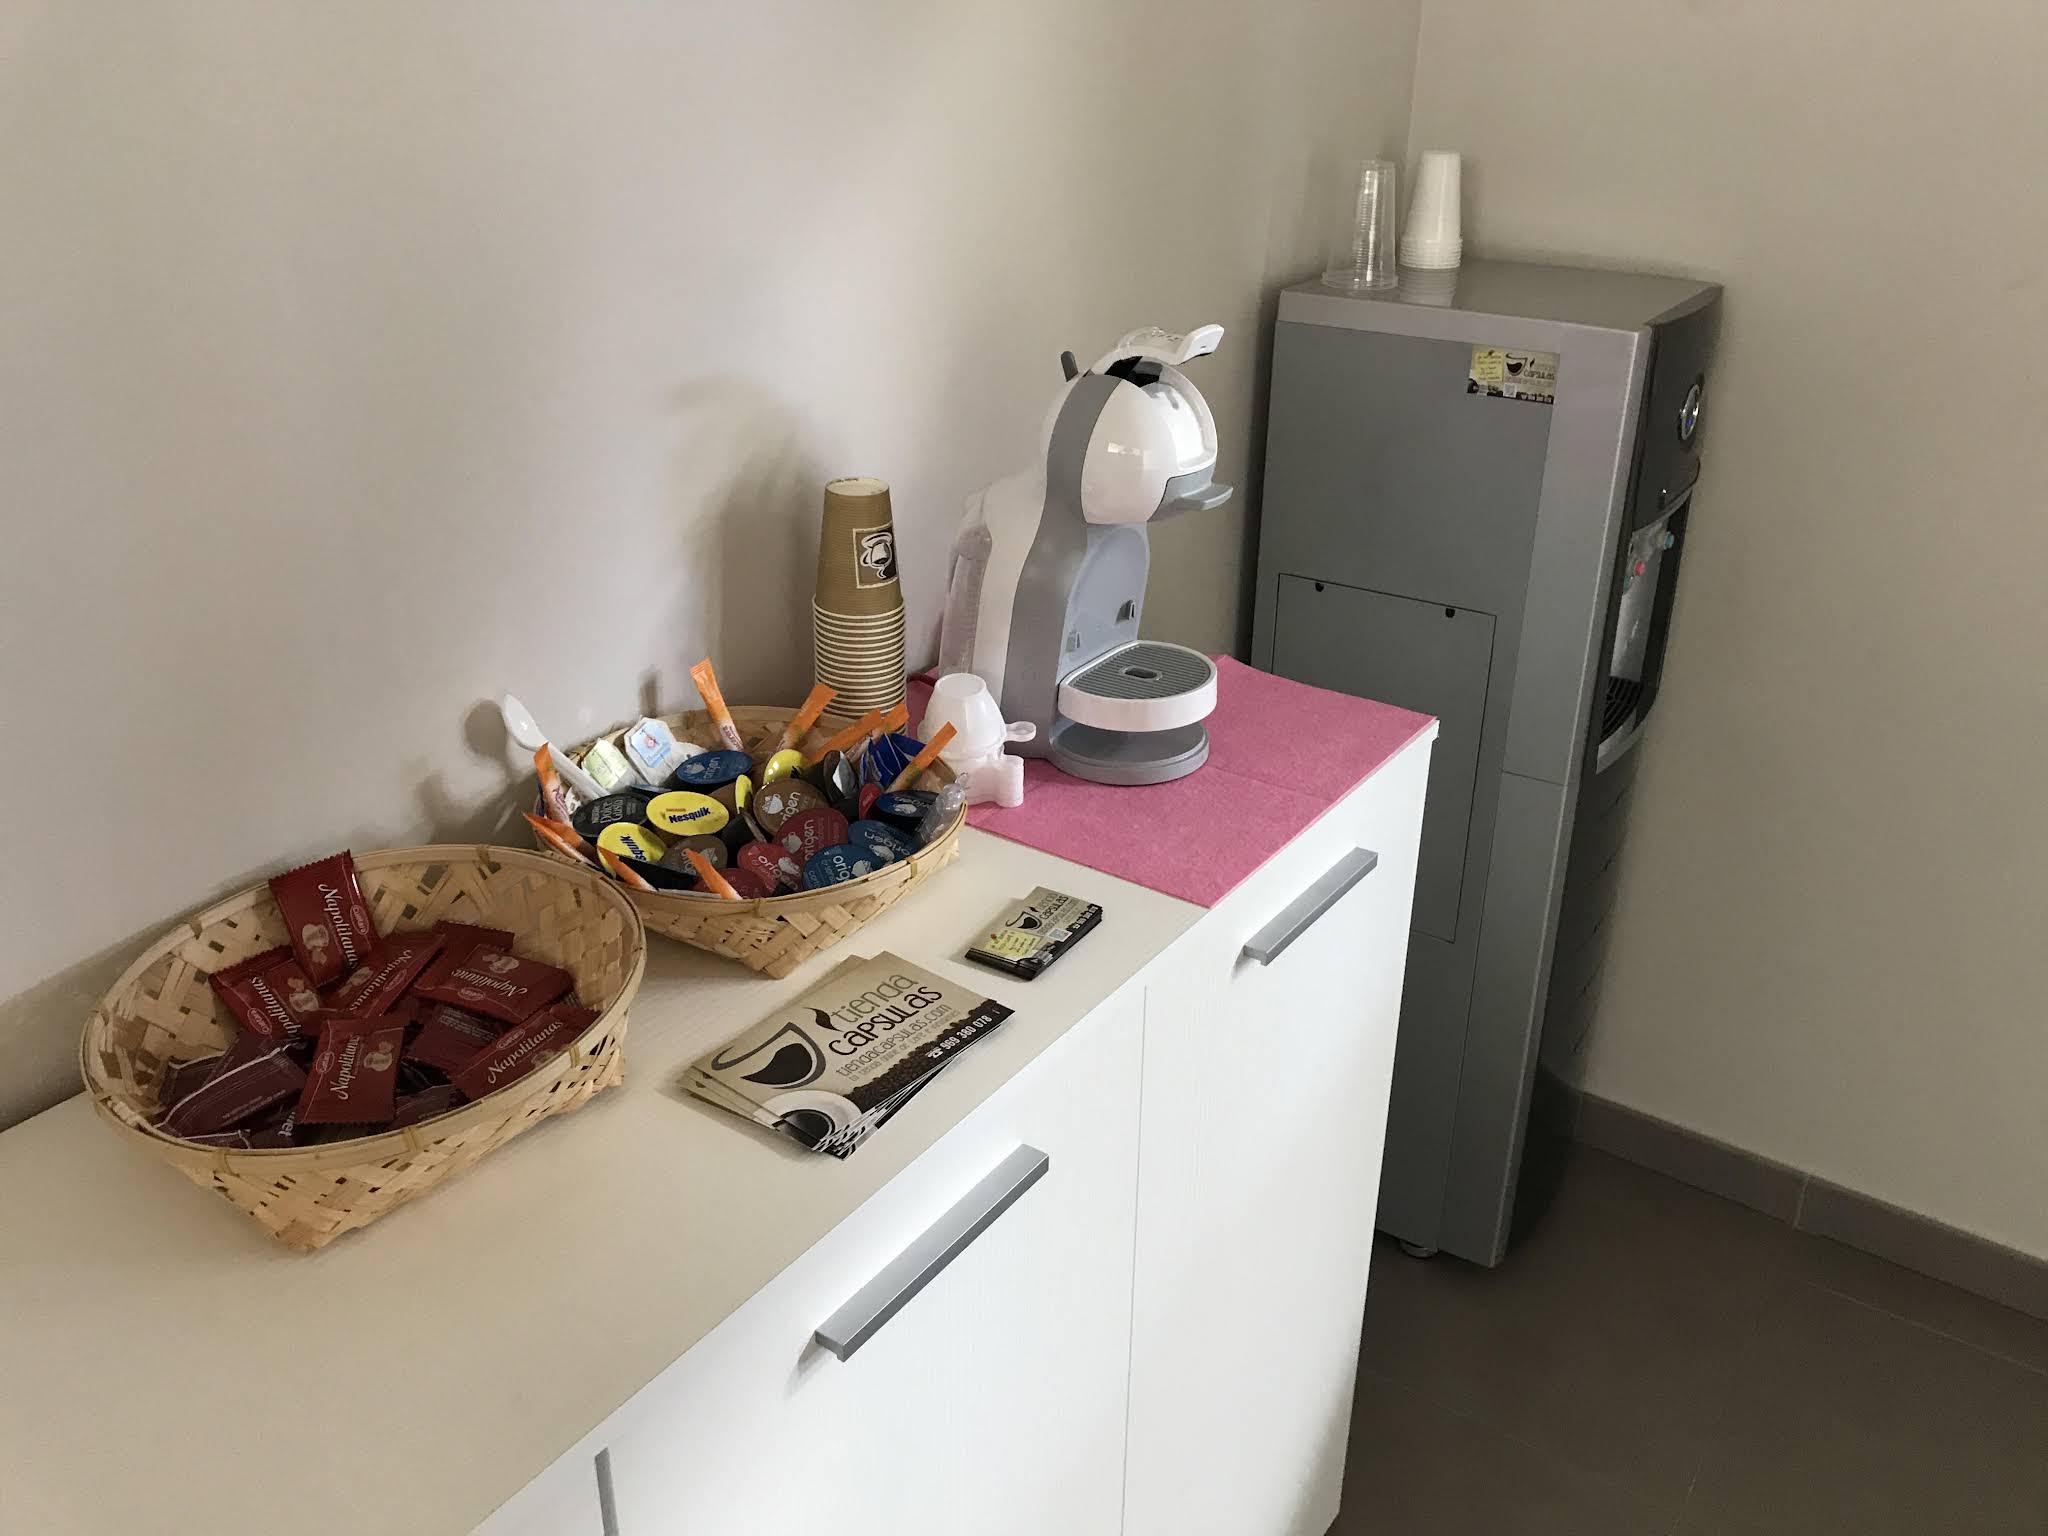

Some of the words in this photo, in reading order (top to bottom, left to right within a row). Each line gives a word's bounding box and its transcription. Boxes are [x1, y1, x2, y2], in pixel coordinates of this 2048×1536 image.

[668, 806, 711, 824] Nesquik
[779, 791, 801, 826] rigen
[619, 834, 649, 862] squik
[863, 830, 911, 856] origen
[757, 854, 799, 891] origen
[318, 883, 358, 970] Napolitanas
[350, 949, 413, 1013] Napolitanas
[830, 974, 920, 1024] tienda
[251, 975, 303, 1042] apolitanas
[828, 986, 943, 1056] capsulas
[940, 1036, 962, 1050] 969
[956, 1026, 977, 1040] 380
[972, 1014, 993, 1029] 078
[487, 1020, 563, 1084] Napolitanas
[835, 1003, 953, 1077] tiendacapsulas.com
